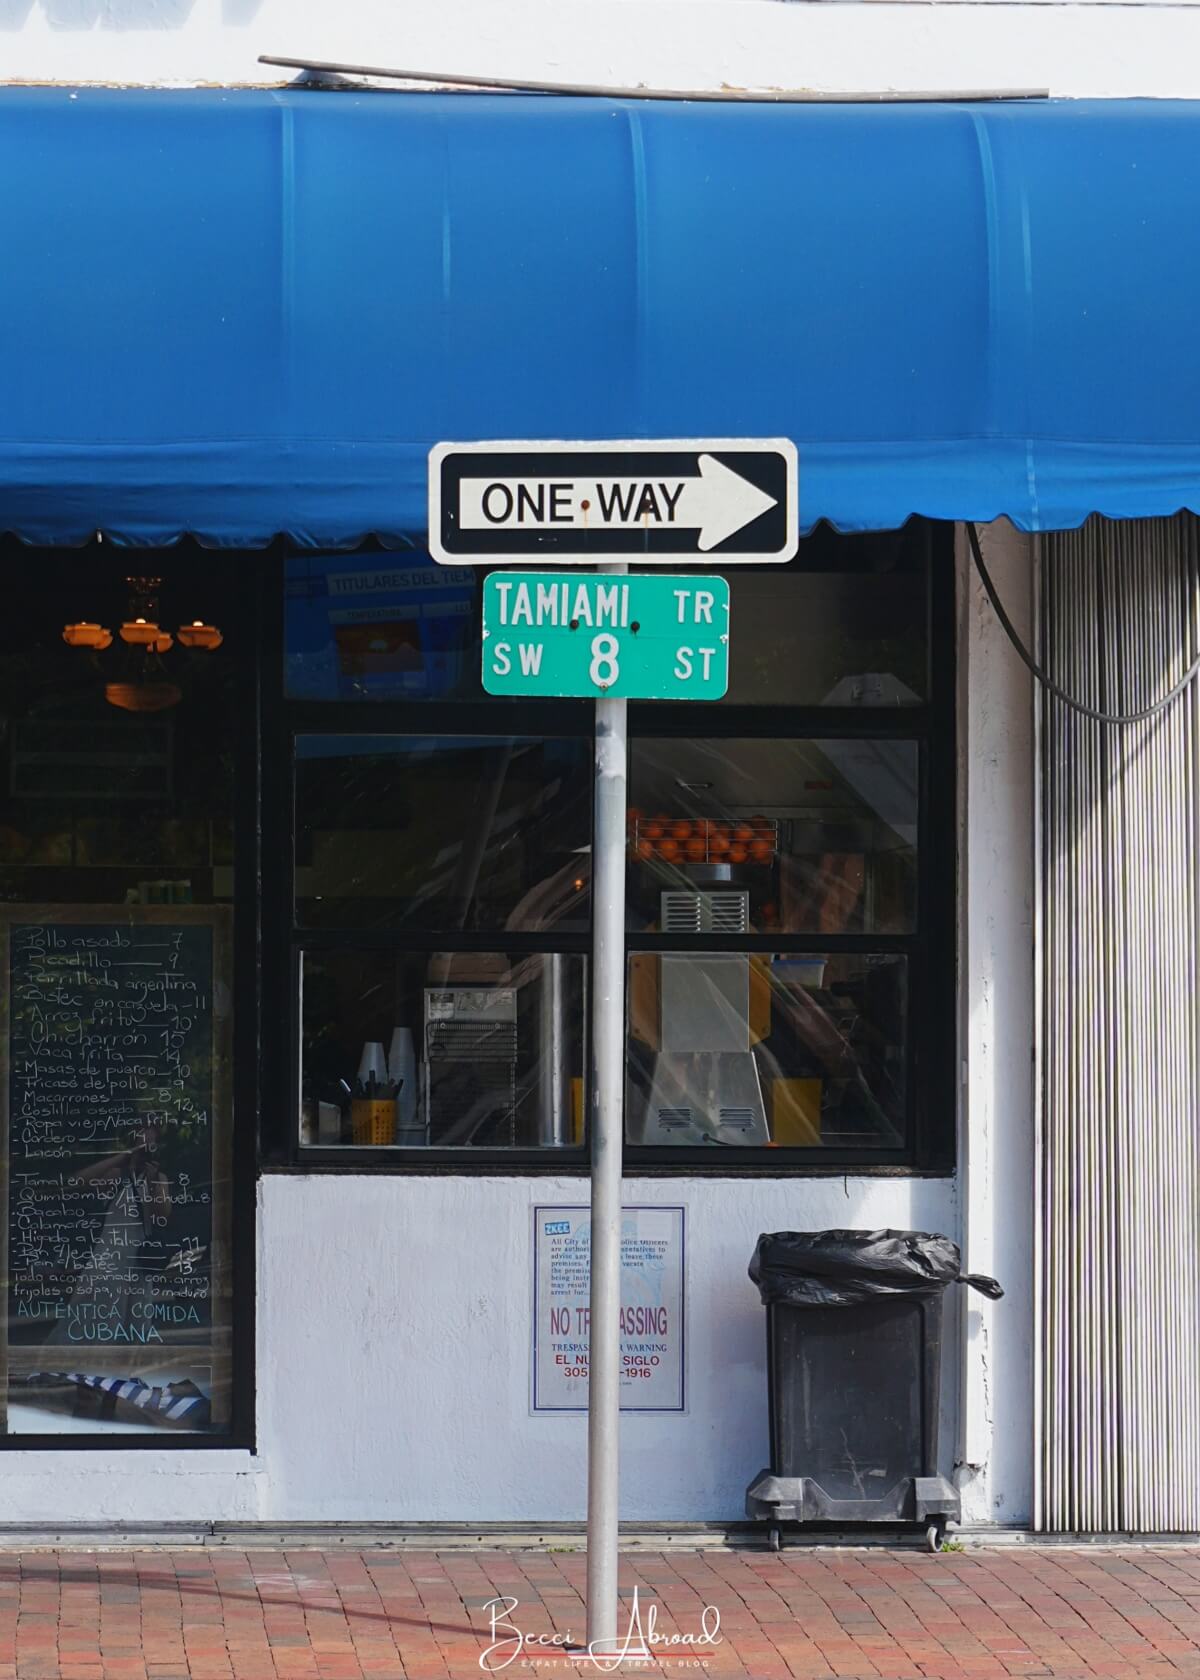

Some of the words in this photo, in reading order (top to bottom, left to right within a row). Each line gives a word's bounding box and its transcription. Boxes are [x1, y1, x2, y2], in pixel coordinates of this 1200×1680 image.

[482, 483, 574, 523] ONE
[596, 483, 686, 523] WAY
[495, 582, 629, 628] TAMIAMI
[673, 590, 714, 624] TR
[589, 632, 620, 689] 8
[673, 646, 716, 681] ST
[16, 927, 67, 948] Pollo
[72, 930, 131, 948] asado
[172, 932, 183, 950] 7
[18, 946, 112, 968] Picadillo
[169, 953, 178, 968] 9
[17, 985, 84, 1006] Bistec
[127, 972, 197, 1003] argentina
[31, 1002, 83, 1032] Arroz
[160, 1031, 184, 1049] 15
[30, 1043, 72, 1058] Vaca
[80, 1046, 124, 1063] frita
[25, 1060, 76, 1078] Masas
[79, 1056, 100, 1075] de
[173, 1063, 191, 1078] 10
[84, 1076, 106, 1089] de
[109, 1076, 148, 1095] pollo
[24, 1090, 111, 1106] Macarrones
[21, 1102, 80, 1117] Costilla
[16, 1116, 62, 1135] Ropa
[21, 1128, 76, 1143] Cordero
[15, 1172, 63, 1186] Tamal
[67, 1177, 85, 1186] en
[178, 1172, 190, 1186] 8
[118, 1203, 140, 1218] 15
[17, 1216, 102, 1231] Calamares
[150, 1215, 168, 1228] 10
[75, 1234, 87, 1243] a
[564, 1238, 580, 1247] City
[14, 1285, 61, 1304] frijoles
[131, 1301, 200, 1324] COMIDA
[551, 1307, 570, 1336] NO
[67, 1320, 164, 1344] CUBANA
[626, 1344, 668, 1352] WARNING
[555, 1354, 571, 1365] EL
[623, 1355, 660, 1366] SIGLO
